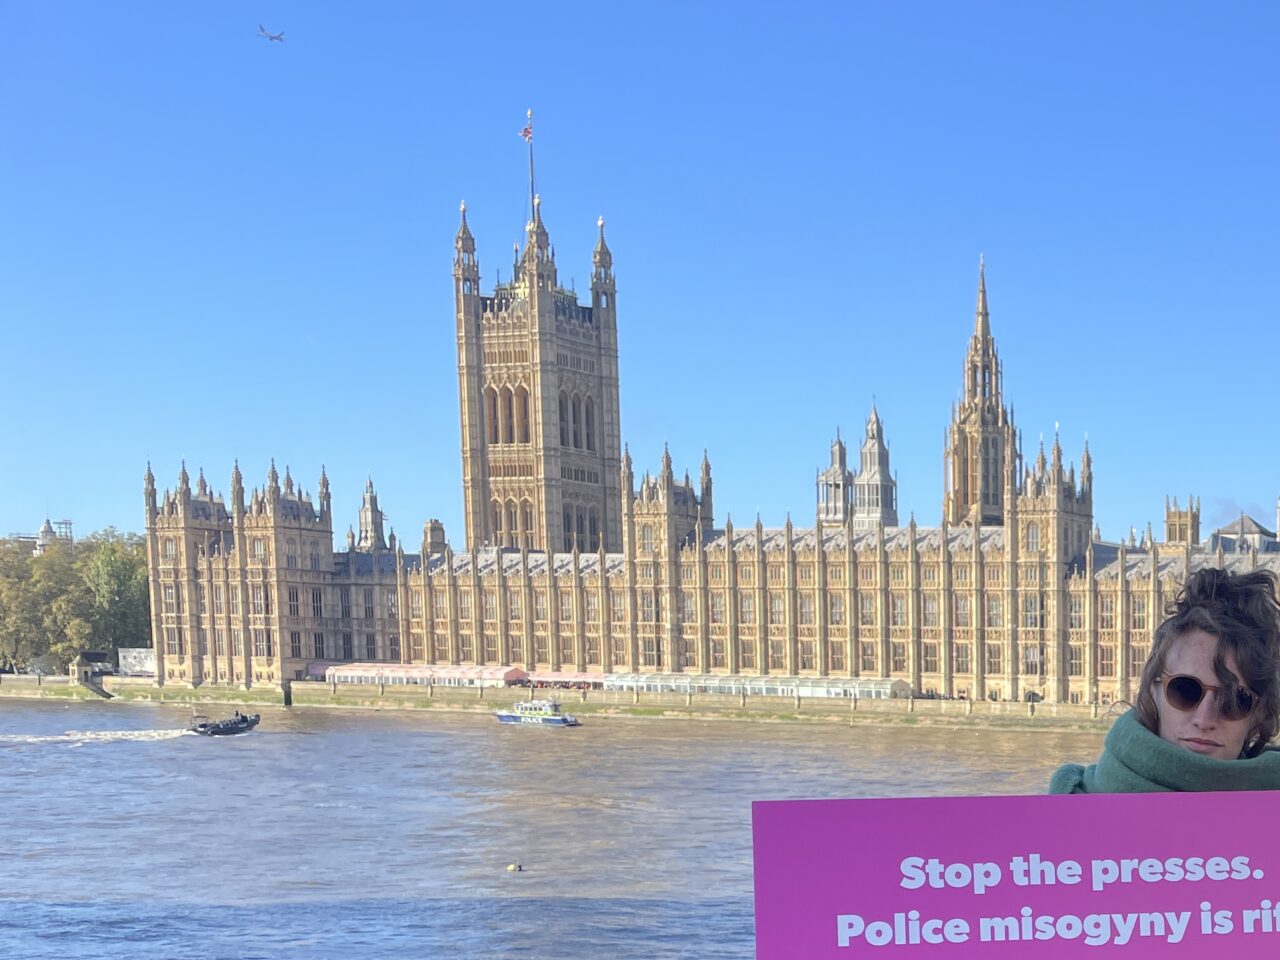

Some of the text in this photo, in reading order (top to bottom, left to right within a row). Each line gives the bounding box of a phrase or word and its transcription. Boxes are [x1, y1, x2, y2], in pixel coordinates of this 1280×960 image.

[899, 853, 1265, 895] Stop the presses.
[836, 909, 971, 947] Police
[979, 906, 1192, 947] misogyny
[1199, 901, 1234, 935] is
